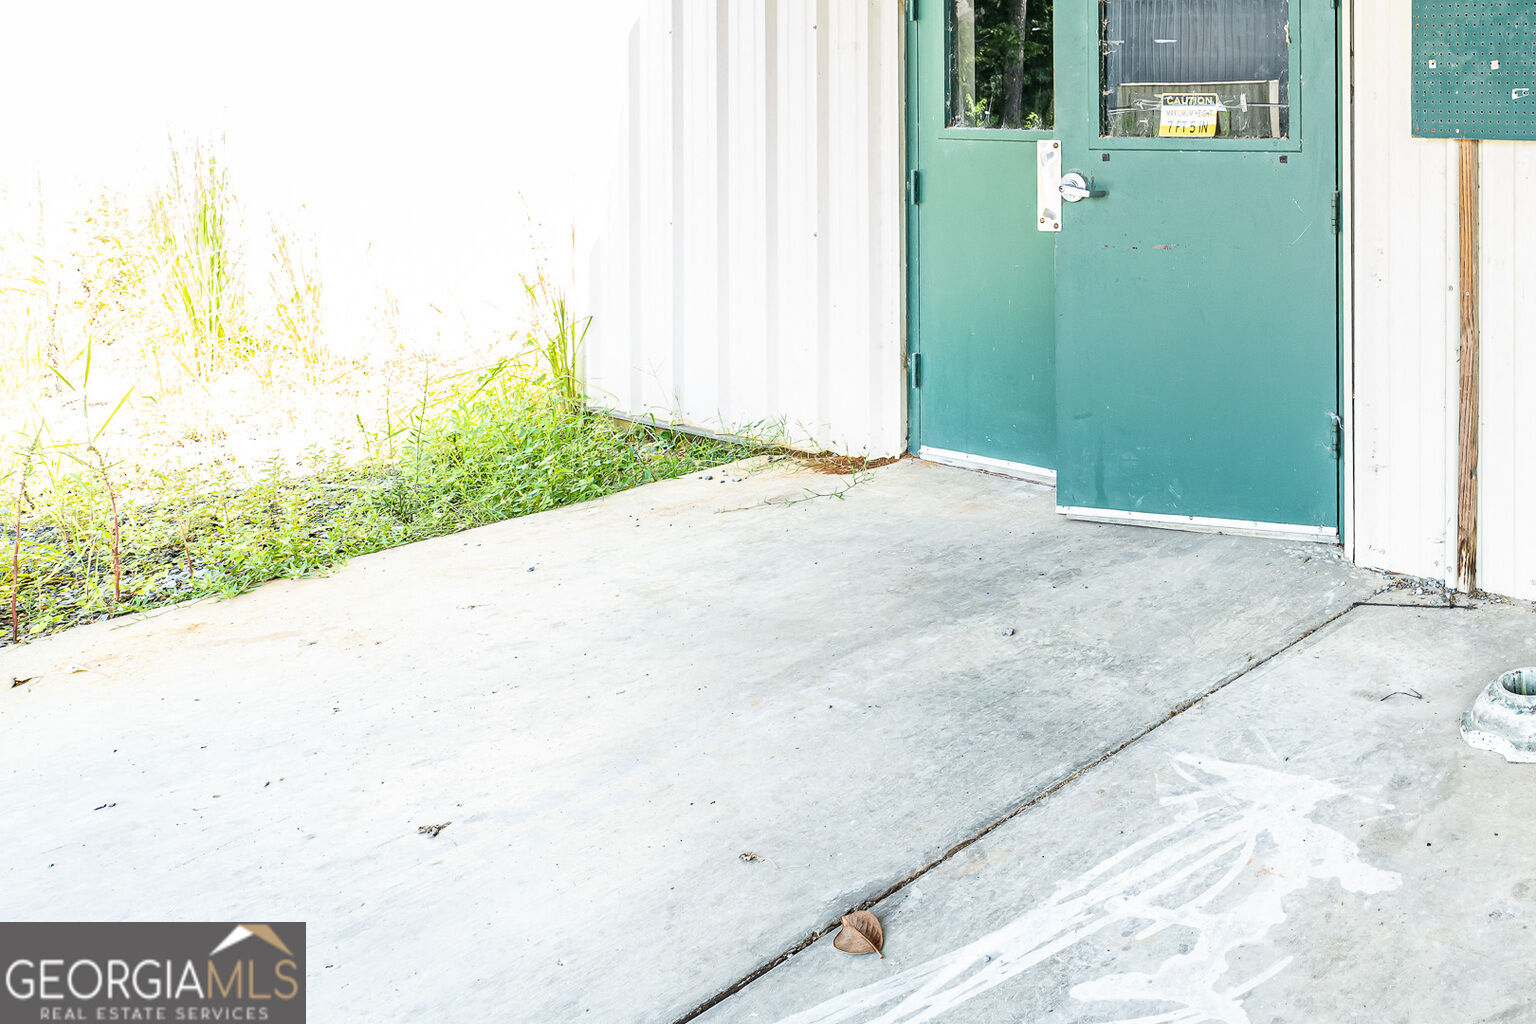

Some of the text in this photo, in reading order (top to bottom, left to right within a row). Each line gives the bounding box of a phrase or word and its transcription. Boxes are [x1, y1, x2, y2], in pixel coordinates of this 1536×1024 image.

[1166, 96, 1213, 105] CAUTION
[1168, 120, 1174, 134] 7
[1175, 120, 1187, 134] FT
[1198, 120, 1209, 134] IN
